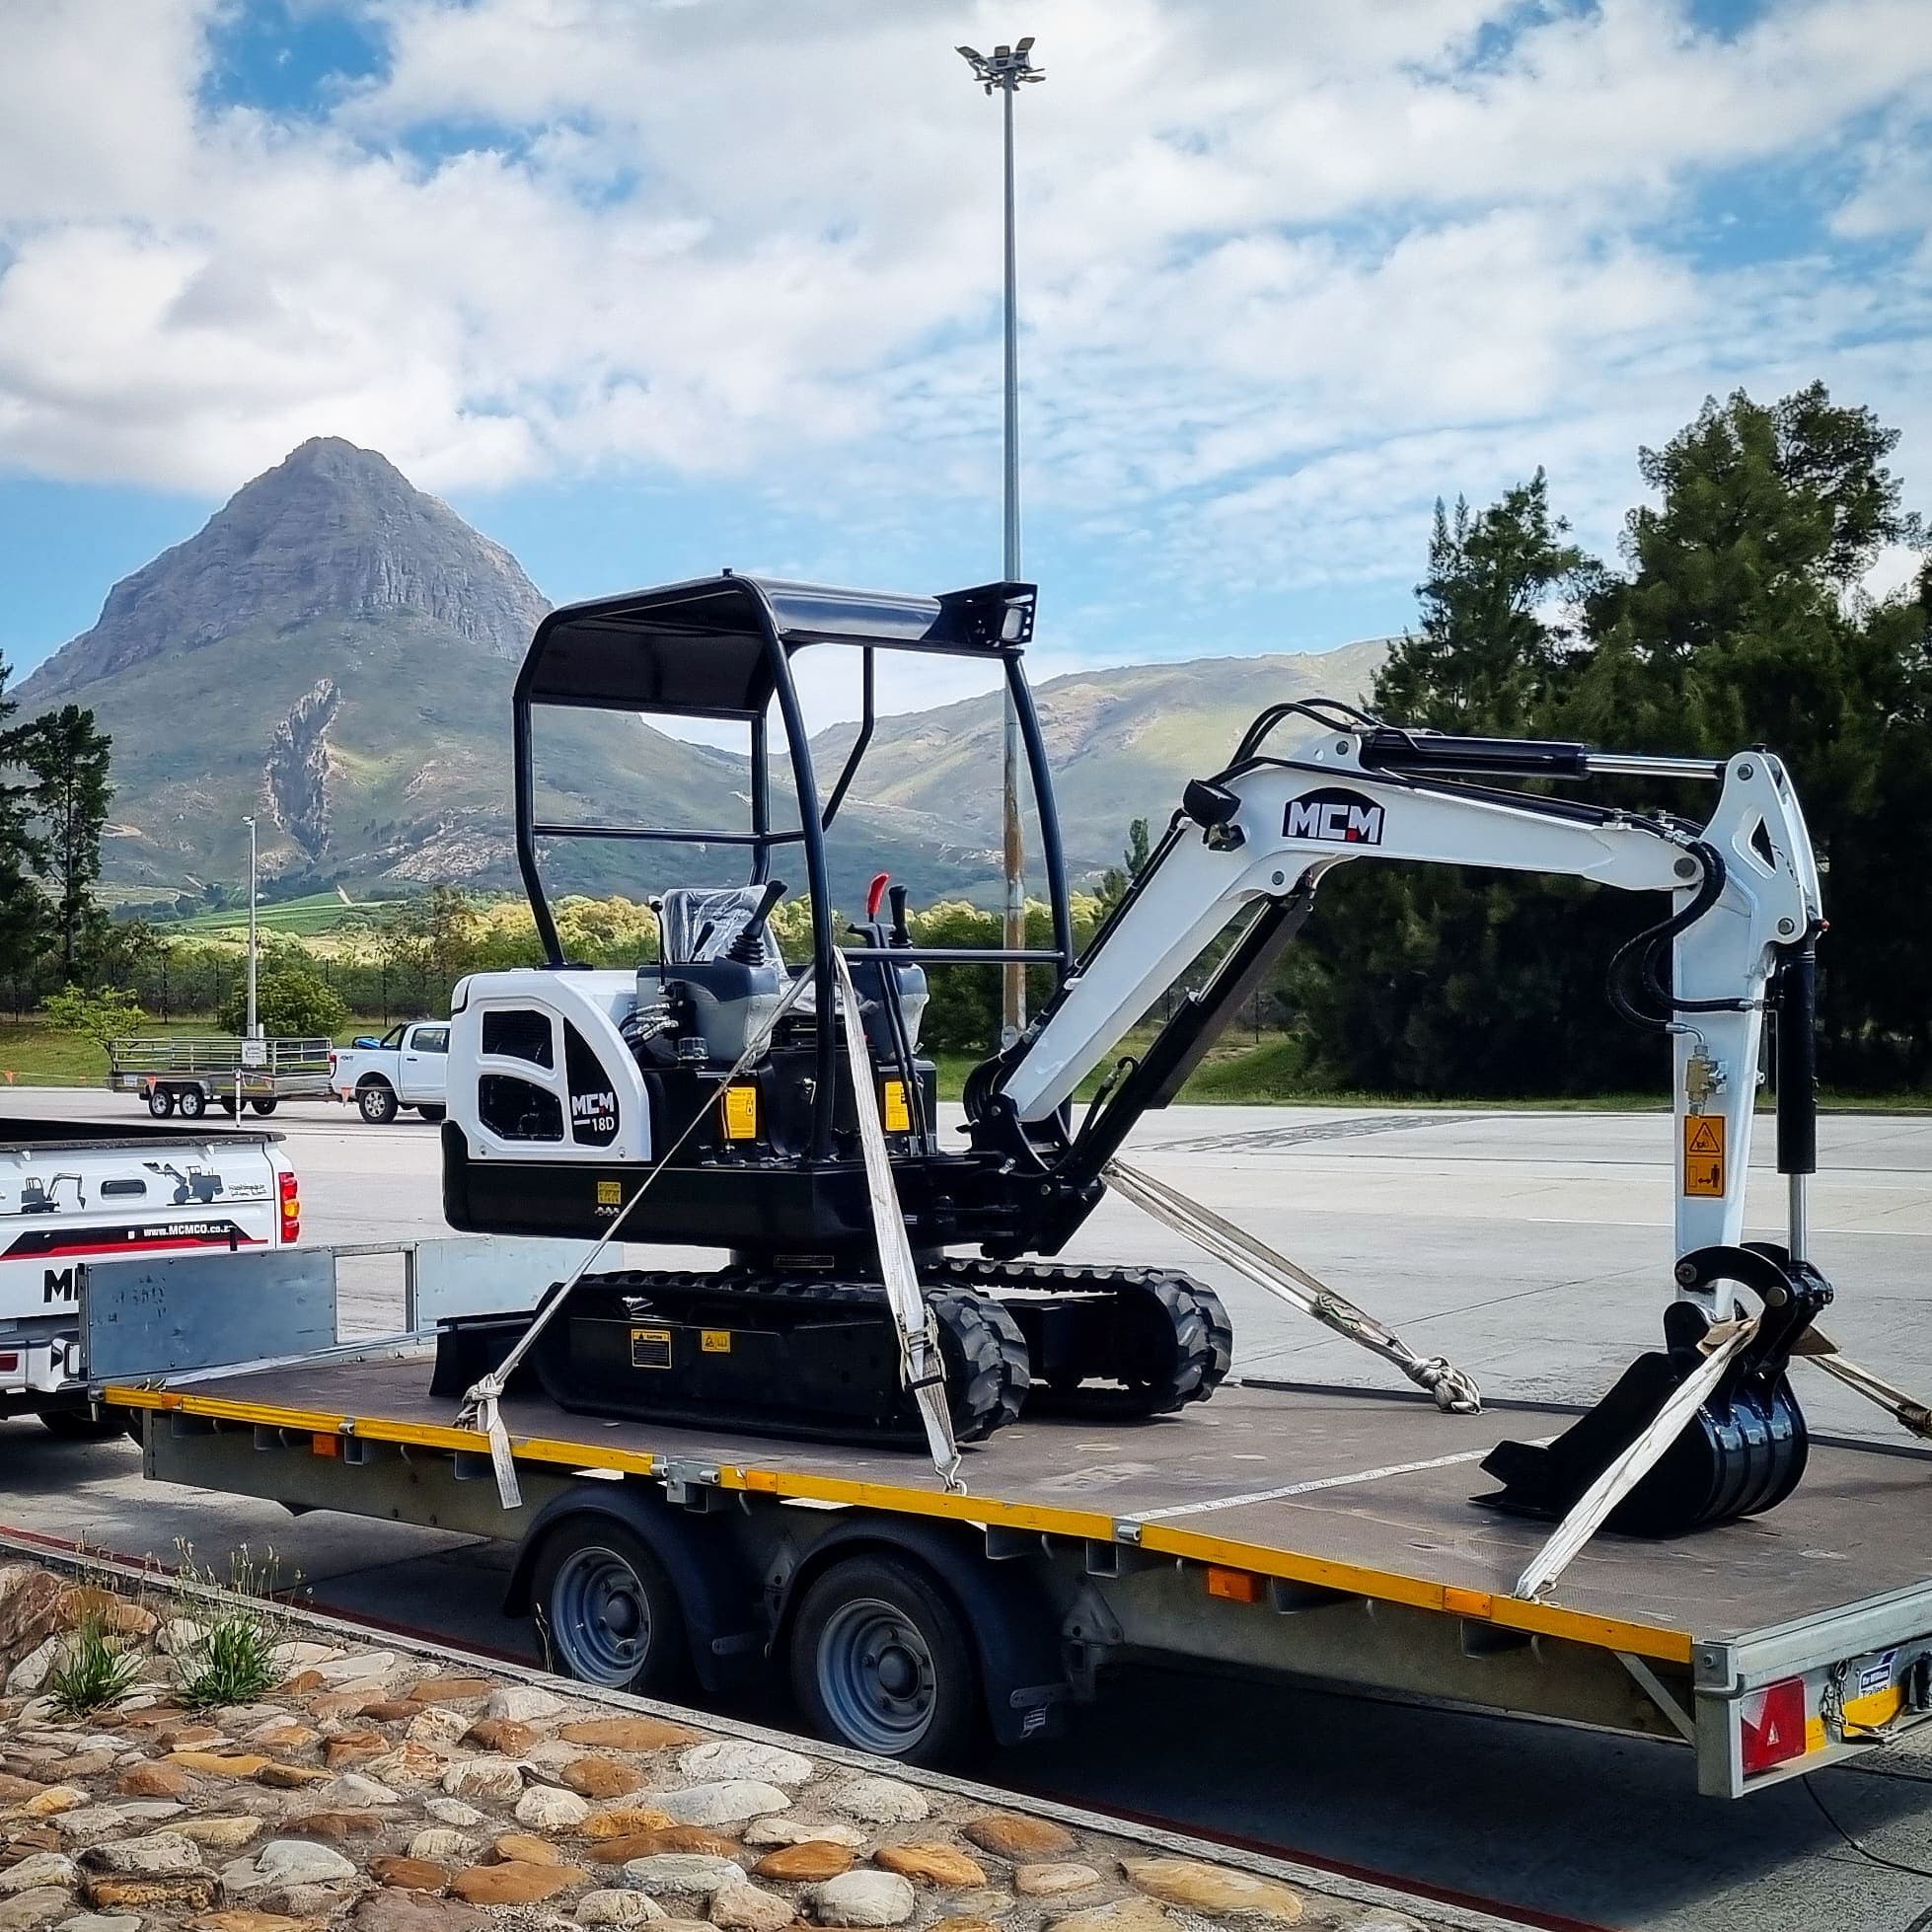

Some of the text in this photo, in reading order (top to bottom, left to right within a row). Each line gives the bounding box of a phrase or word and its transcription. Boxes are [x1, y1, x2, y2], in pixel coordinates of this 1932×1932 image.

[1288, 801, 1381, 843] MCM
[571, 1091, 615, 1116] MCM
[592, 1116, 615, 1132] 18D
[143, 1225, 232, 1237] www.MCMCO.co.z
[43, 1268, 79, 1302] M
